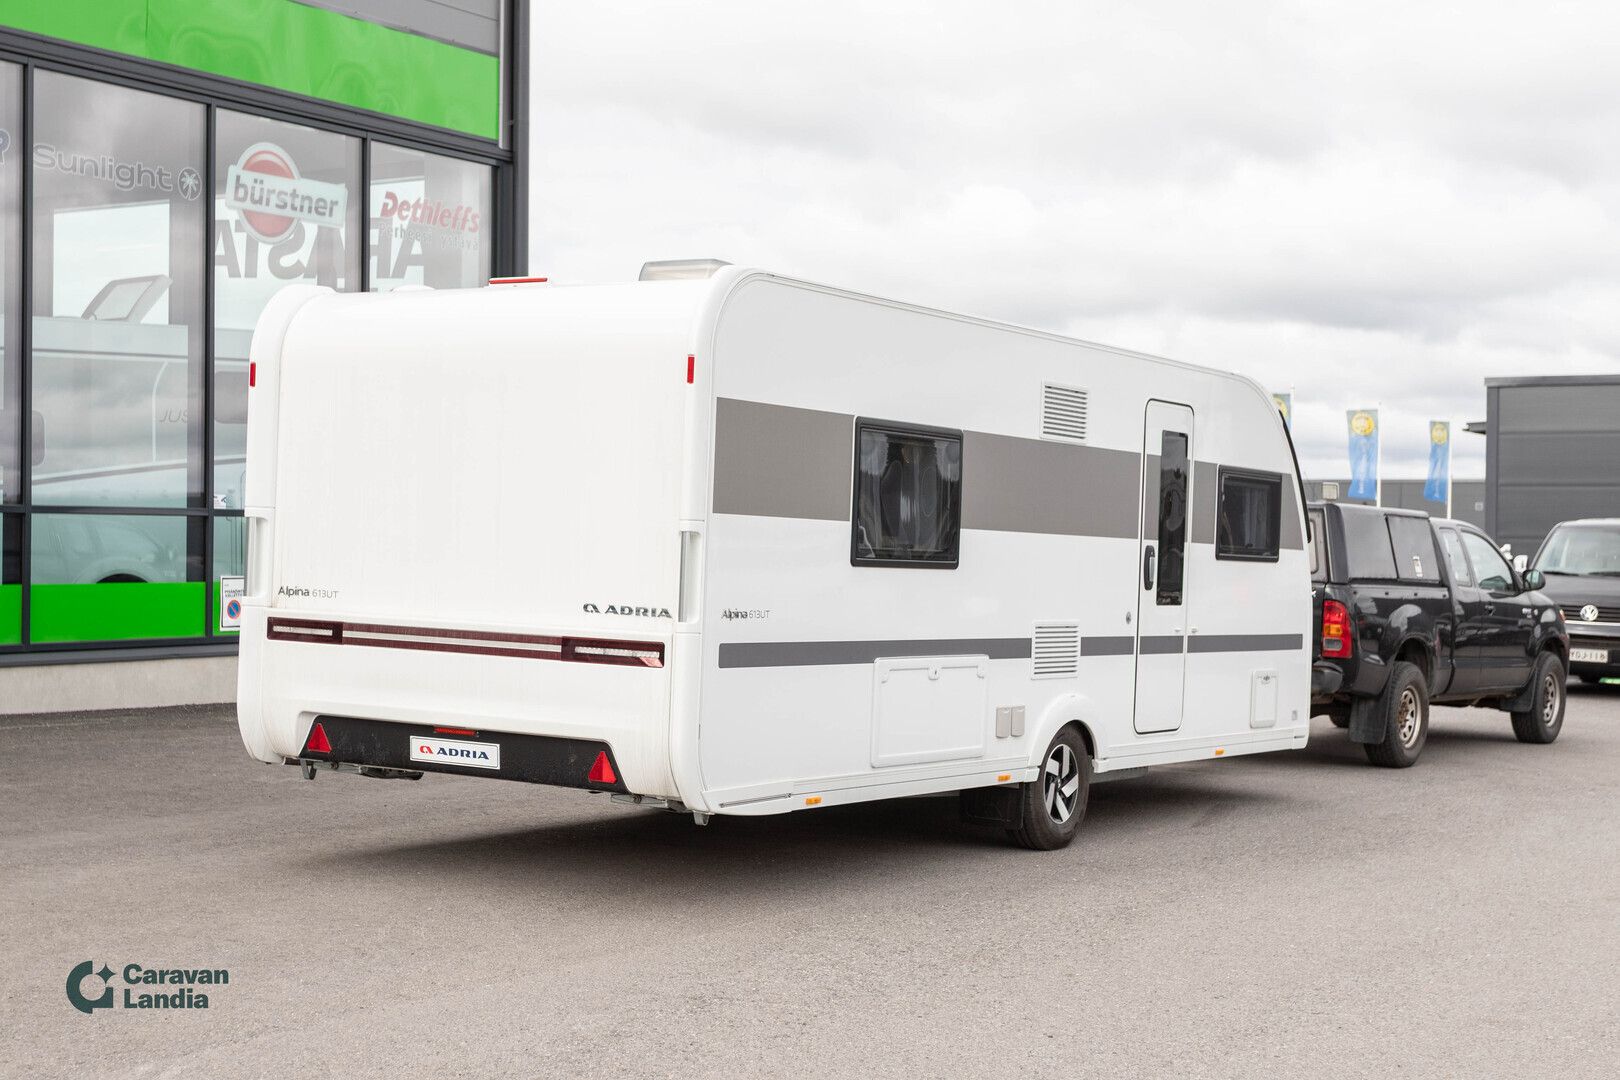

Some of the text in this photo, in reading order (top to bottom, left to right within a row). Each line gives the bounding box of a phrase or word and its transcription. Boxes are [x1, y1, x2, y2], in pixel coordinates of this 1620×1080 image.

[33, 143, 173, 191] Sunlight
[233, 175, 339, 218] bürstner
[380, 191, 480, 234] Dethleffs
[278, 586, 339, 599] Alpina 613UT
[604, 604, 673, 619] ADRIA
[721, 608, 770, 621] Alpina 613UT
[437, 747, 490, 760] ADRIA
